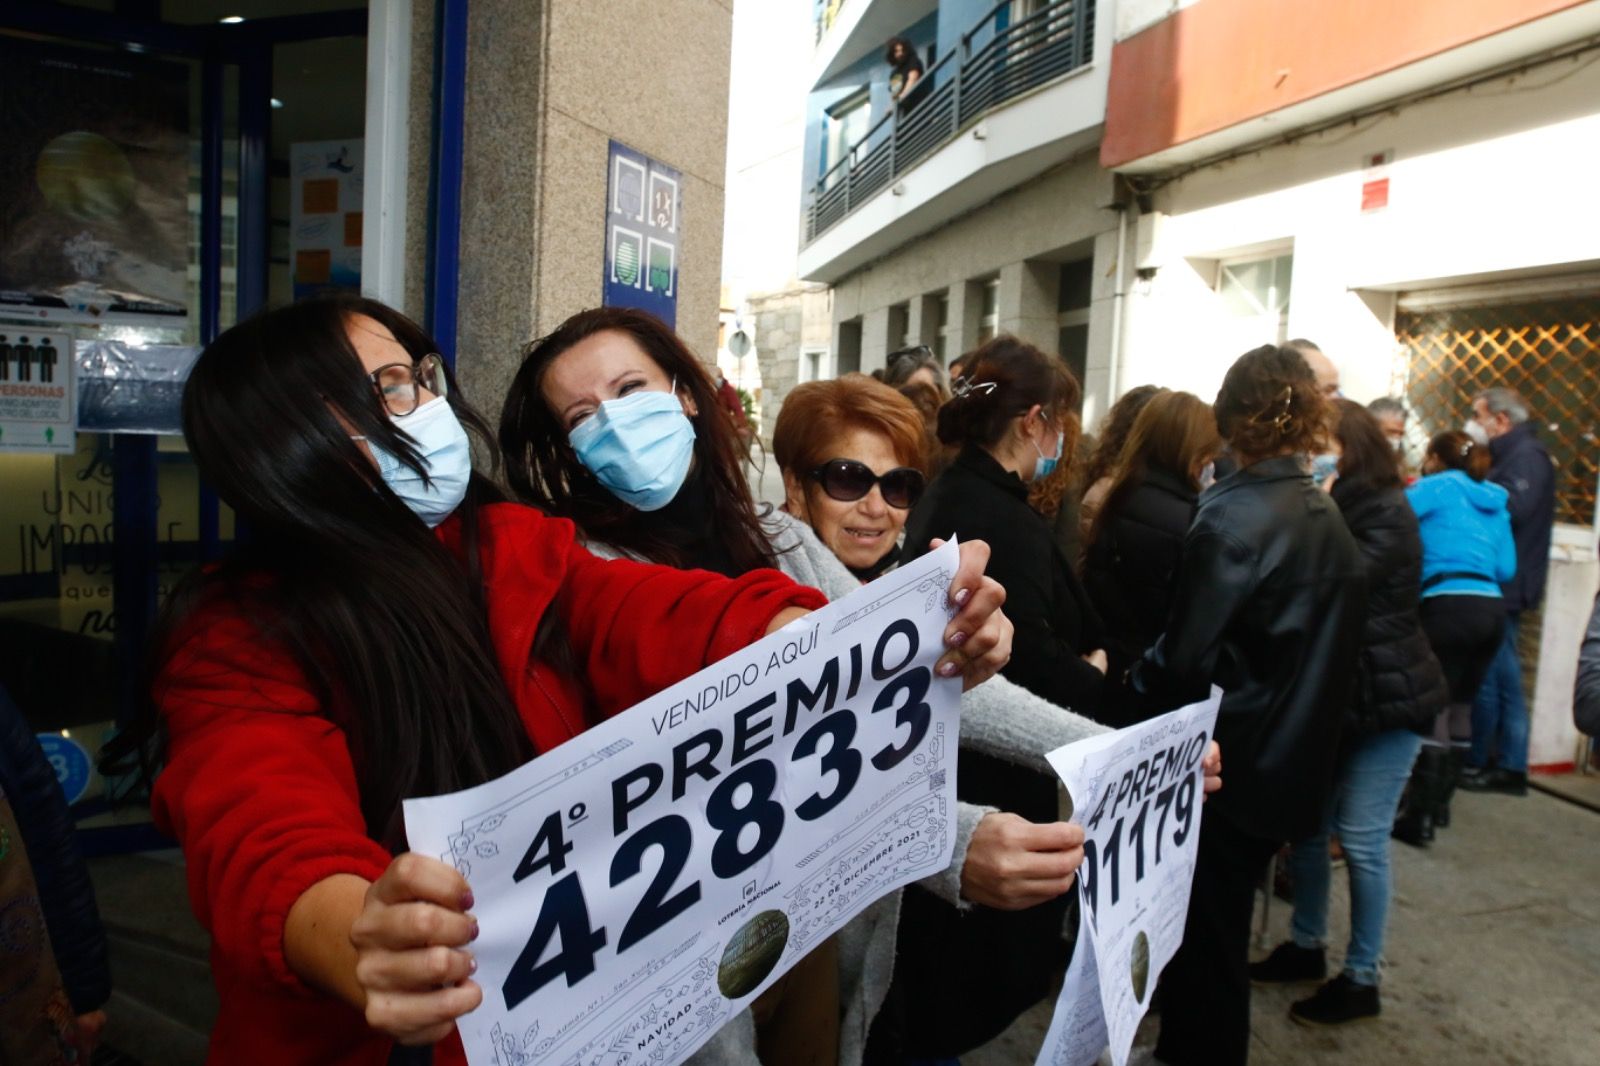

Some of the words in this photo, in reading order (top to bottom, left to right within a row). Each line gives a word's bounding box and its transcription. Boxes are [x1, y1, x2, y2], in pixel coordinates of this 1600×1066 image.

[0, 384, 65, 398] ERSONAS
[611, 618, 920, 838] PREMIO
[651, 663, 759, 736] VENDIDO
[765, 622, 820, 677] AQUÍ
[1110, 730, 1207, 820] PREMIO
[501, 665, 932, 1012] 42833
[828, 885, 840, 897] DE
[843, 844, 894, 886] DICIEMBRE
[896, 830, 920, 847] 2021
[1078, 771, 1196, 937] 91179
[637, 1003, 692, 1050] NAVIDAD
